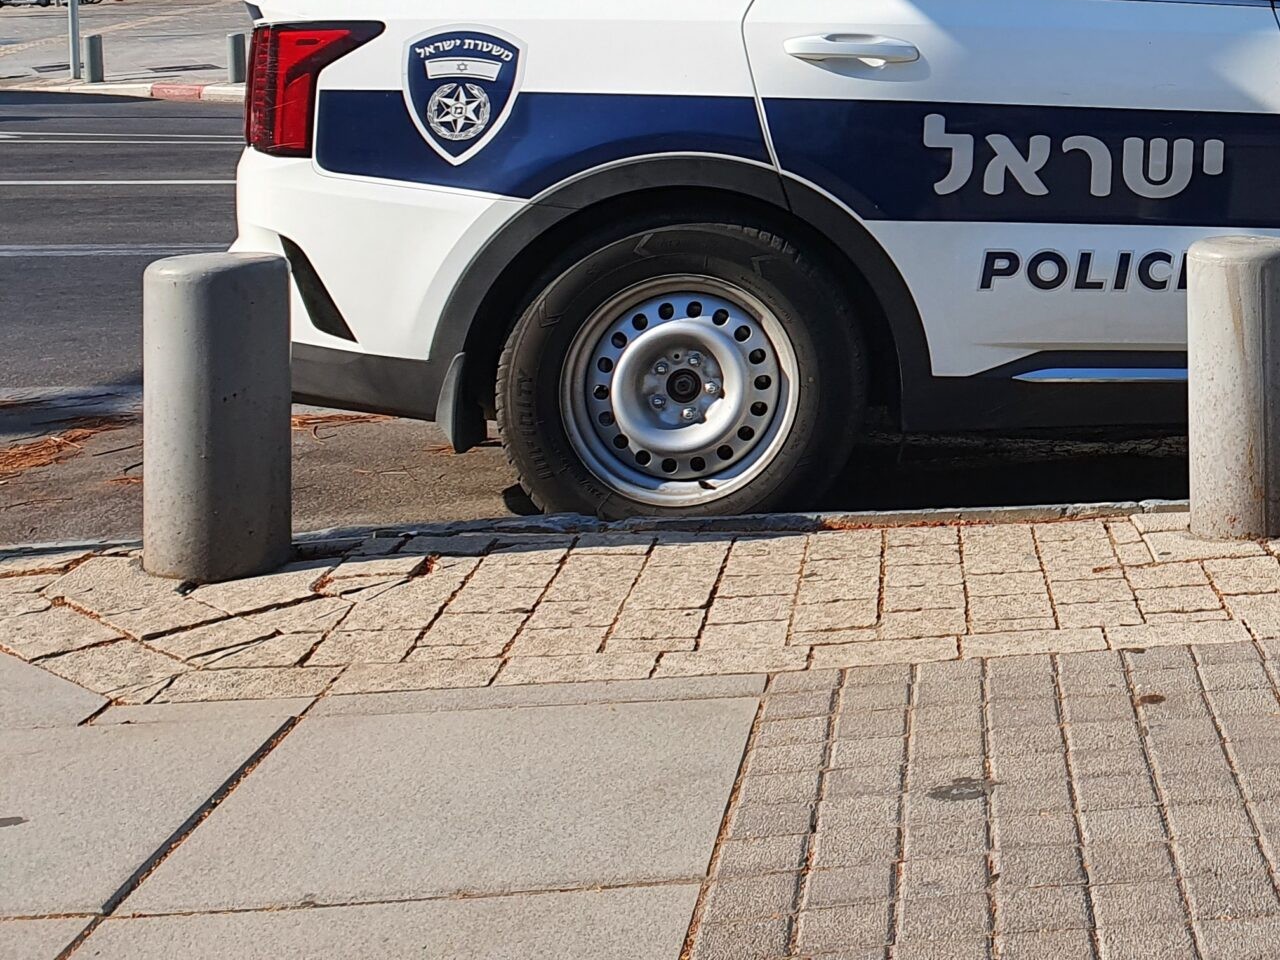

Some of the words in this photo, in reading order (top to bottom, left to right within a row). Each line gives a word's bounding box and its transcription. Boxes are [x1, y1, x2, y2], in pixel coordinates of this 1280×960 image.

[415, 38, 461, 58] ישראל
[463, 38, 514, 62] משטרת
[923, 112, 1225, 197] ישראל
[978, 249, 1188, 292] POLIC
